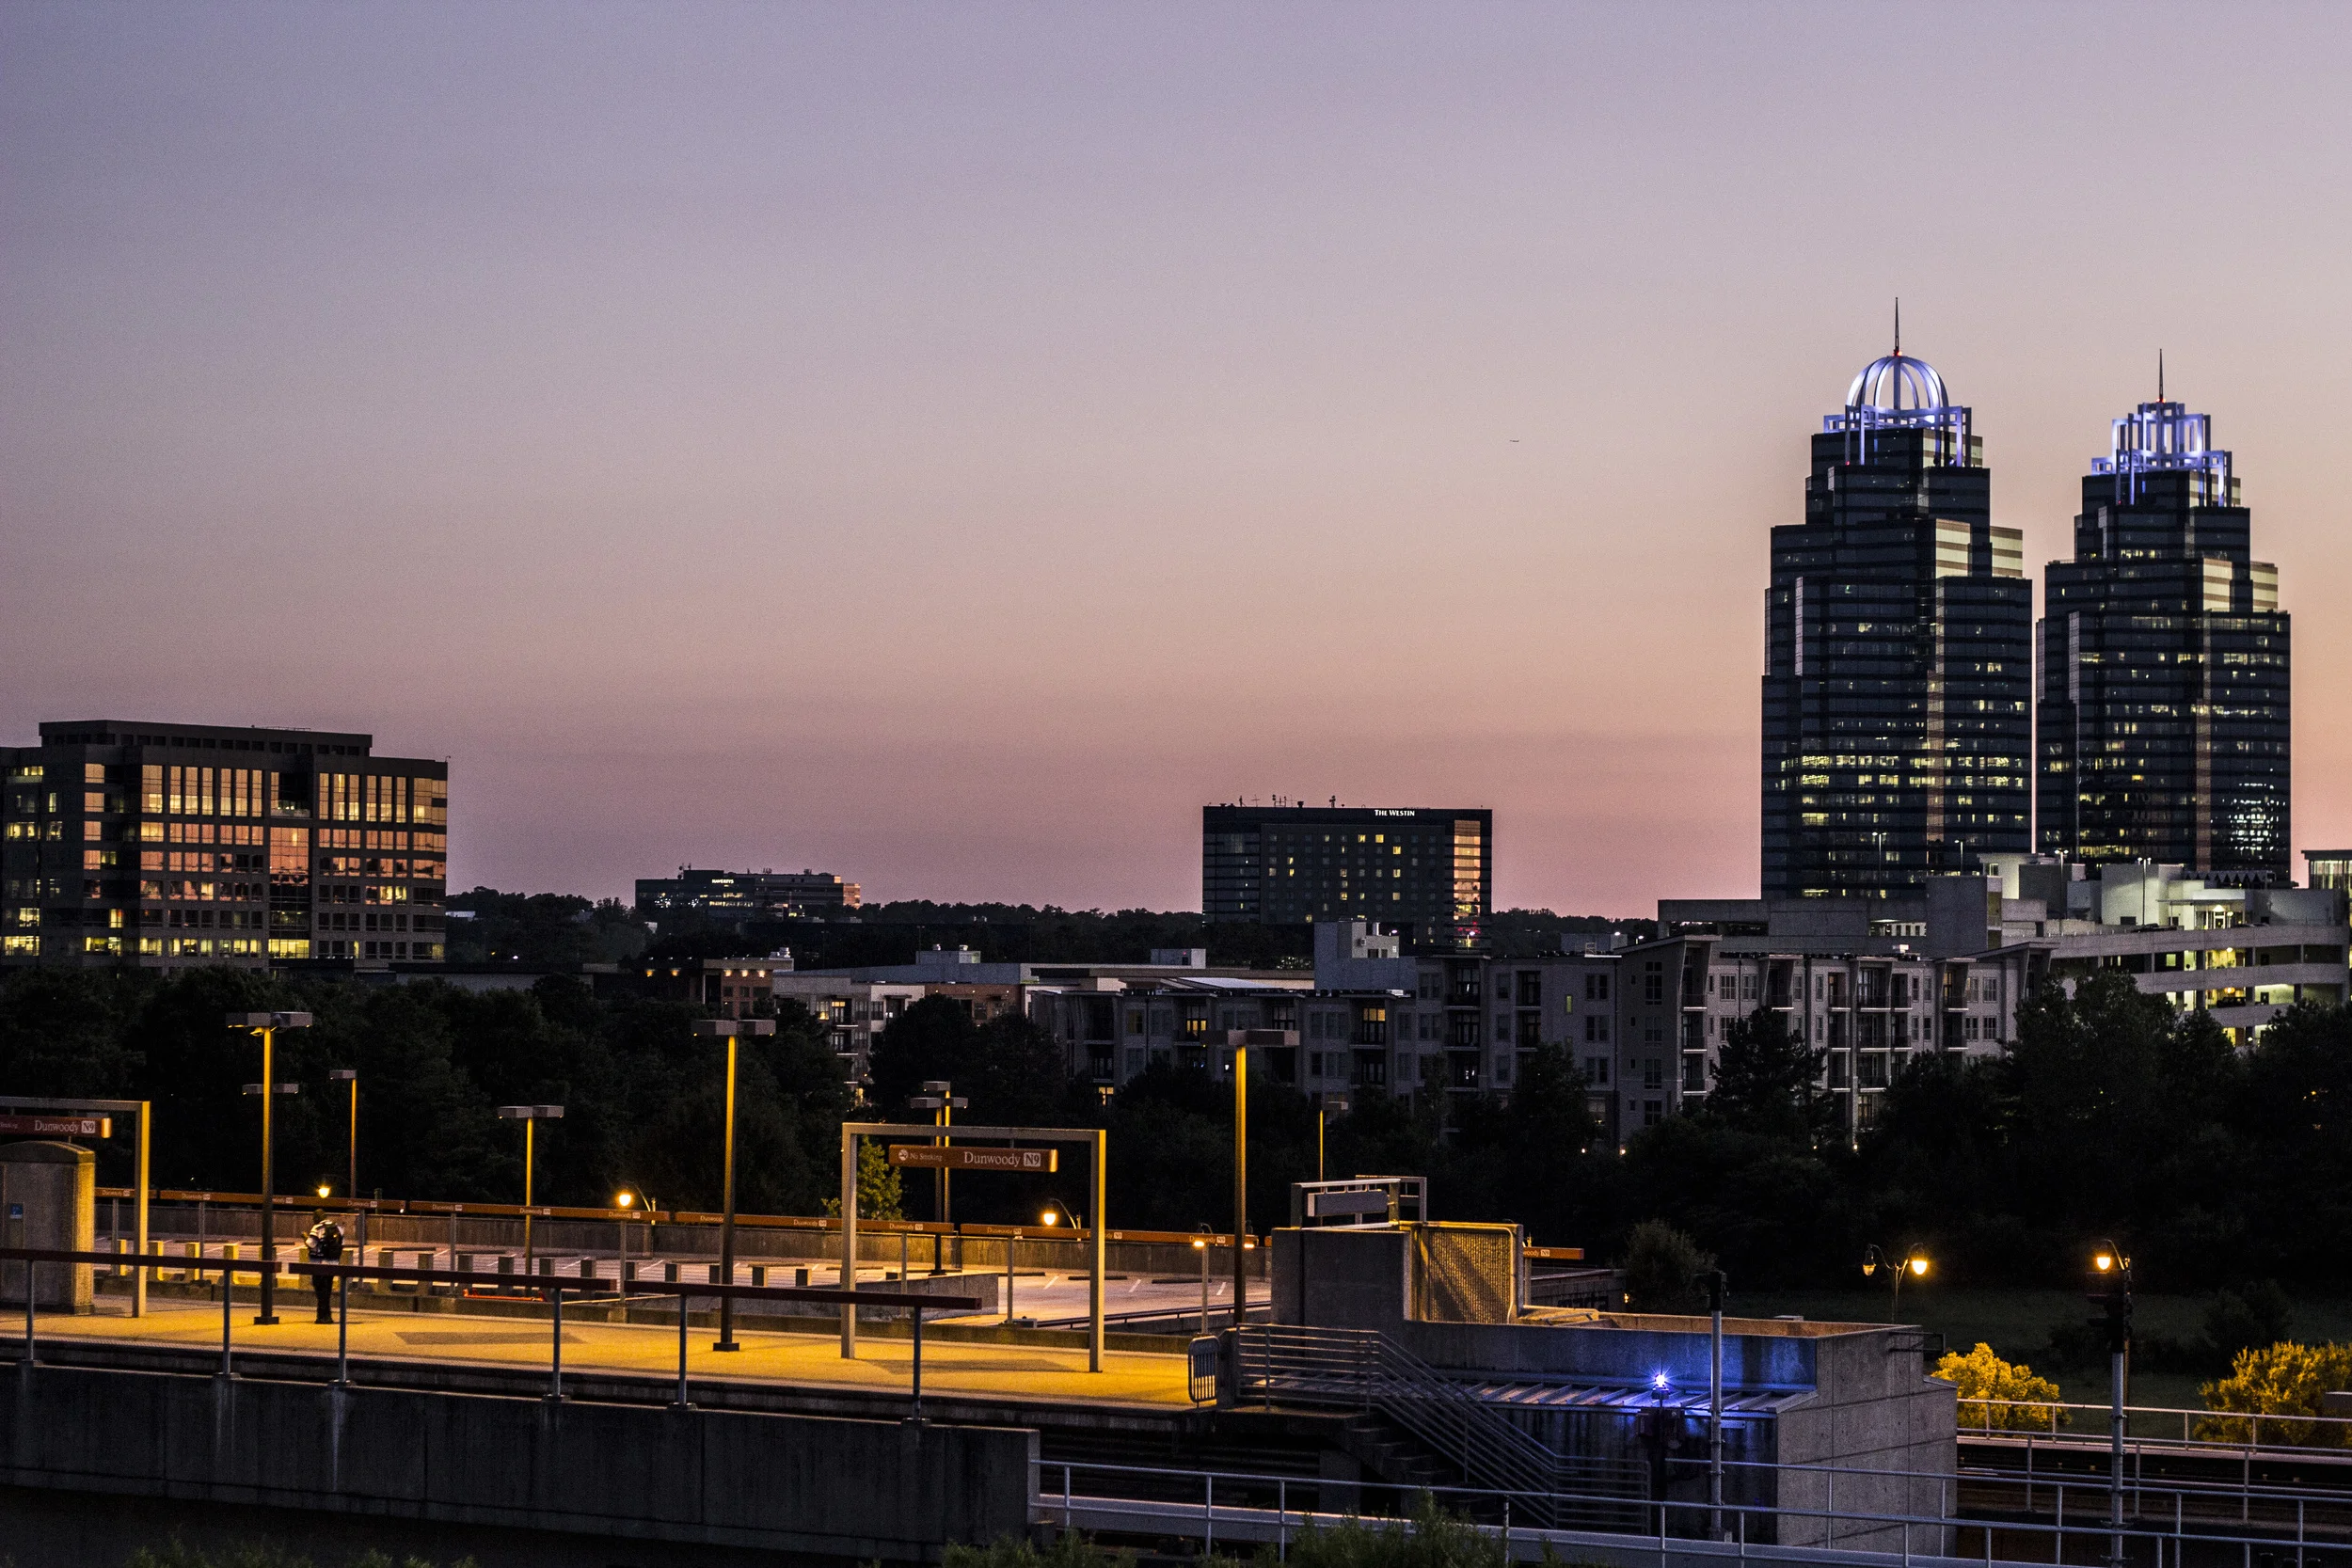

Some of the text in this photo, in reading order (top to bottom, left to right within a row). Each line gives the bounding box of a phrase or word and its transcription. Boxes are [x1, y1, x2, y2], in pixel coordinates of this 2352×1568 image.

[34, 1119, 95, 1134] Dunwoody N9
[963, 1151, 1041, 1167] Dunwoody N9
